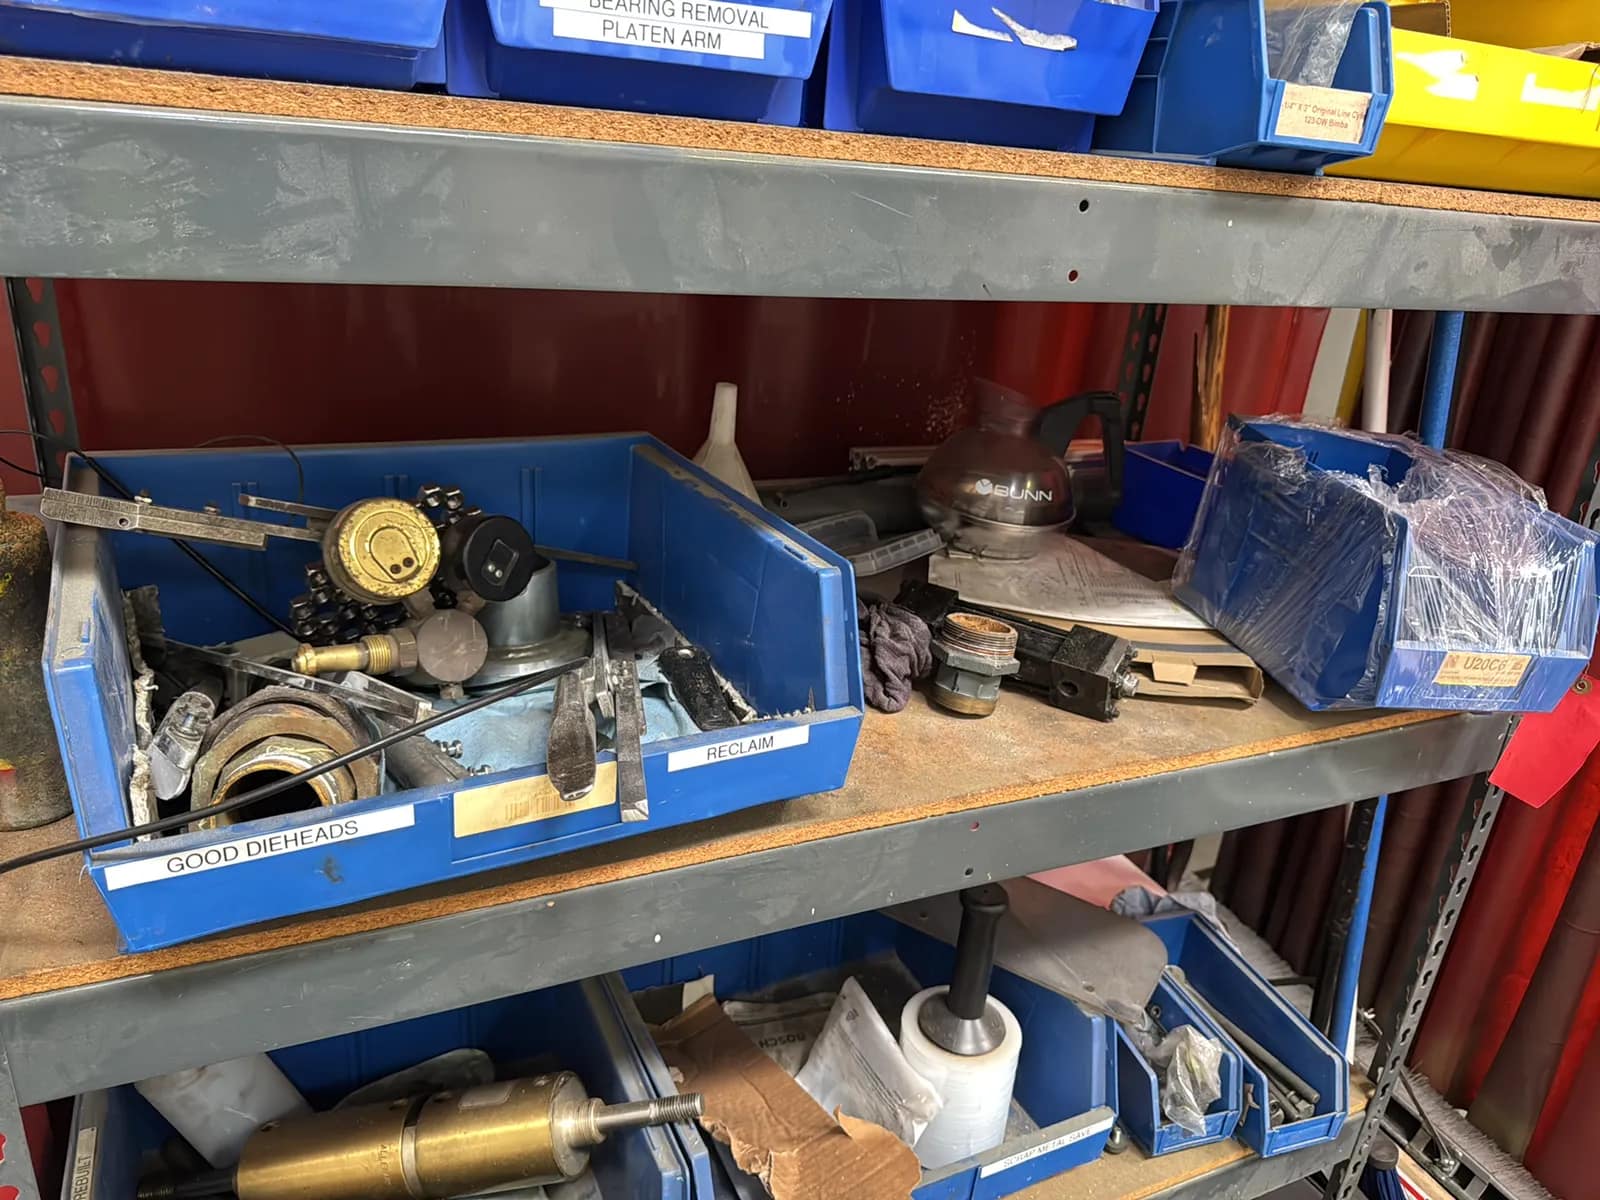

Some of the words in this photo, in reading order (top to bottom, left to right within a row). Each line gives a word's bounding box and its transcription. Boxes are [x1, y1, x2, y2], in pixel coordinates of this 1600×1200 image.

[681, 2, 769, 29] REMOVAL
[602, 19, 675, 45] PLATEN
[681, 29, 722, 50] ARM
[1312, 104, 1337, 117] Original
[1337, 107, 1351, 118] Line
[1329, 118, 1348, 129] Bimba
[994, 484, 1053, 501] BUNN
[1463, 655, 1508, 671] U20C6
[706, 735, 774, 761] RECLAIM
[166, 846, 239, 874] GOOD
[246, 820, 359, 857] DIEHEADS
[1003, 1149, 1036, 1168] SCRAP
[1037, 1138, 1065, 1154] METAL
[1069, 1128, 1091, 1142] SAVE
[72, 1155, 92, 1200] REBUILT
